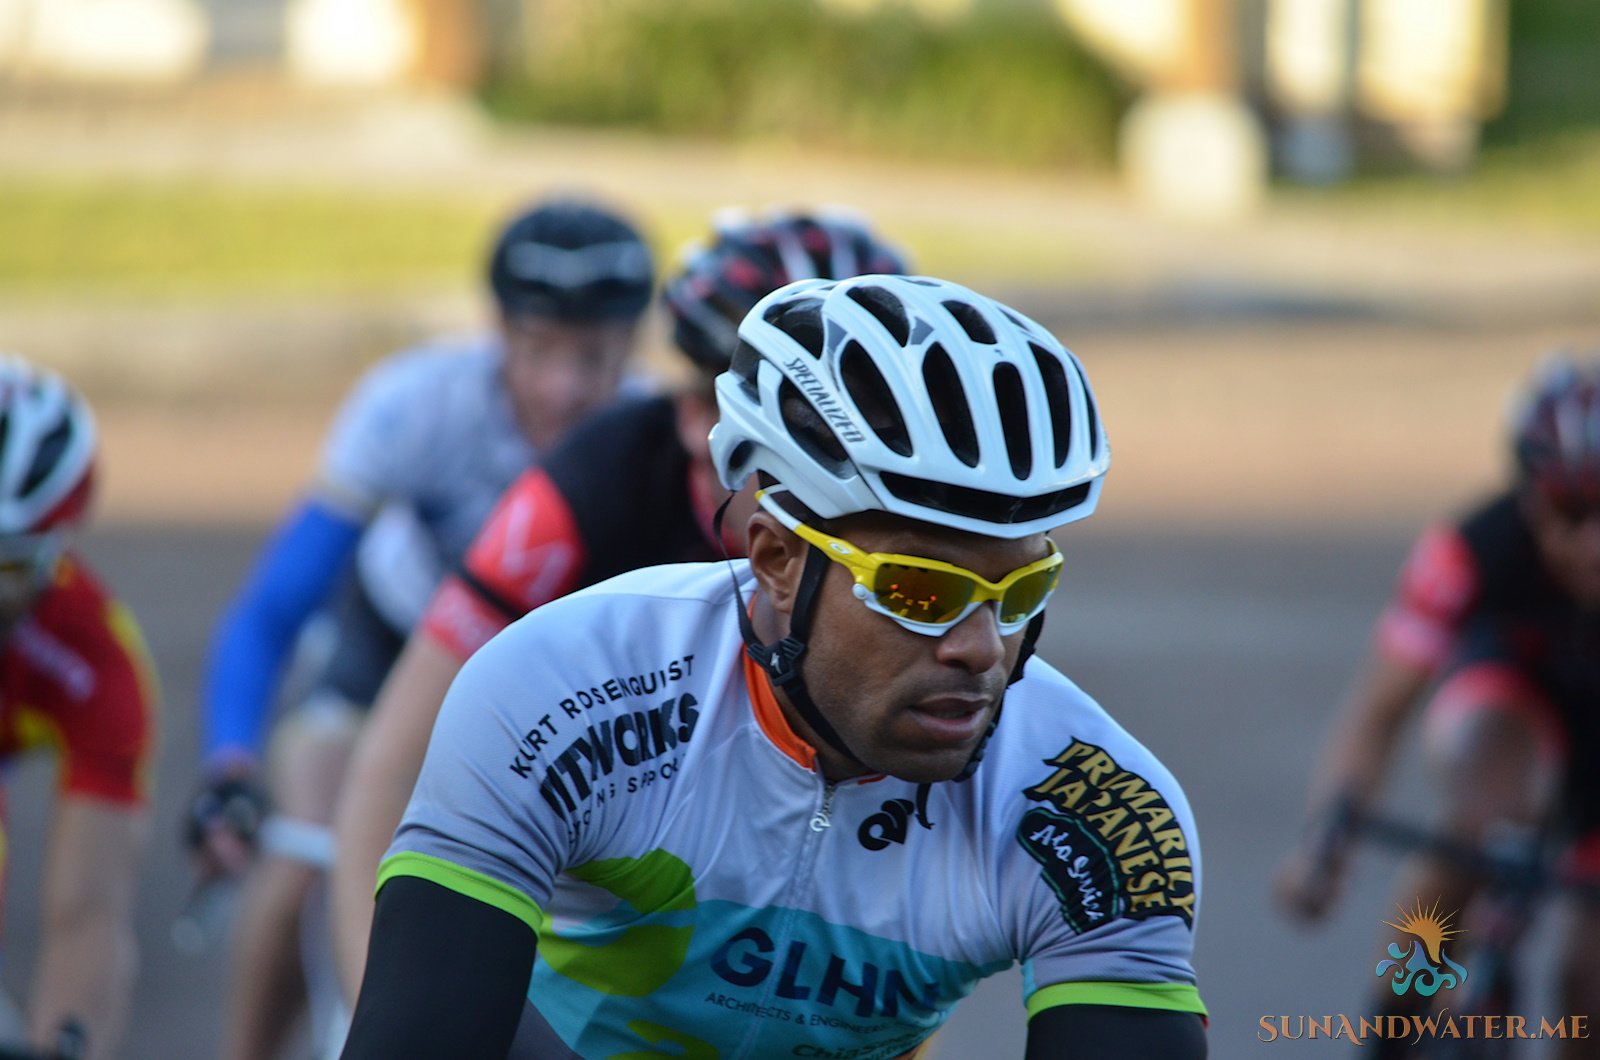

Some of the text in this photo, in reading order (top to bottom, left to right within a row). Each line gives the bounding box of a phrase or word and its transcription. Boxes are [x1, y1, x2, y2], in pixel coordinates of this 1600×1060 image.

[783, 357, 866, 443] SPECIALIZED
[509, 655, 694, 779] KURT ROSENQUIST
[1033, 767, 1168, 912] JAPANESE
[1053, 741, 1195, 917] PRIMARILY
[705, 992, 791, 1022] ARCHITECTS
[795, 1010, 806, 1025] &
[710, 927, 940, 1018] GLHN
